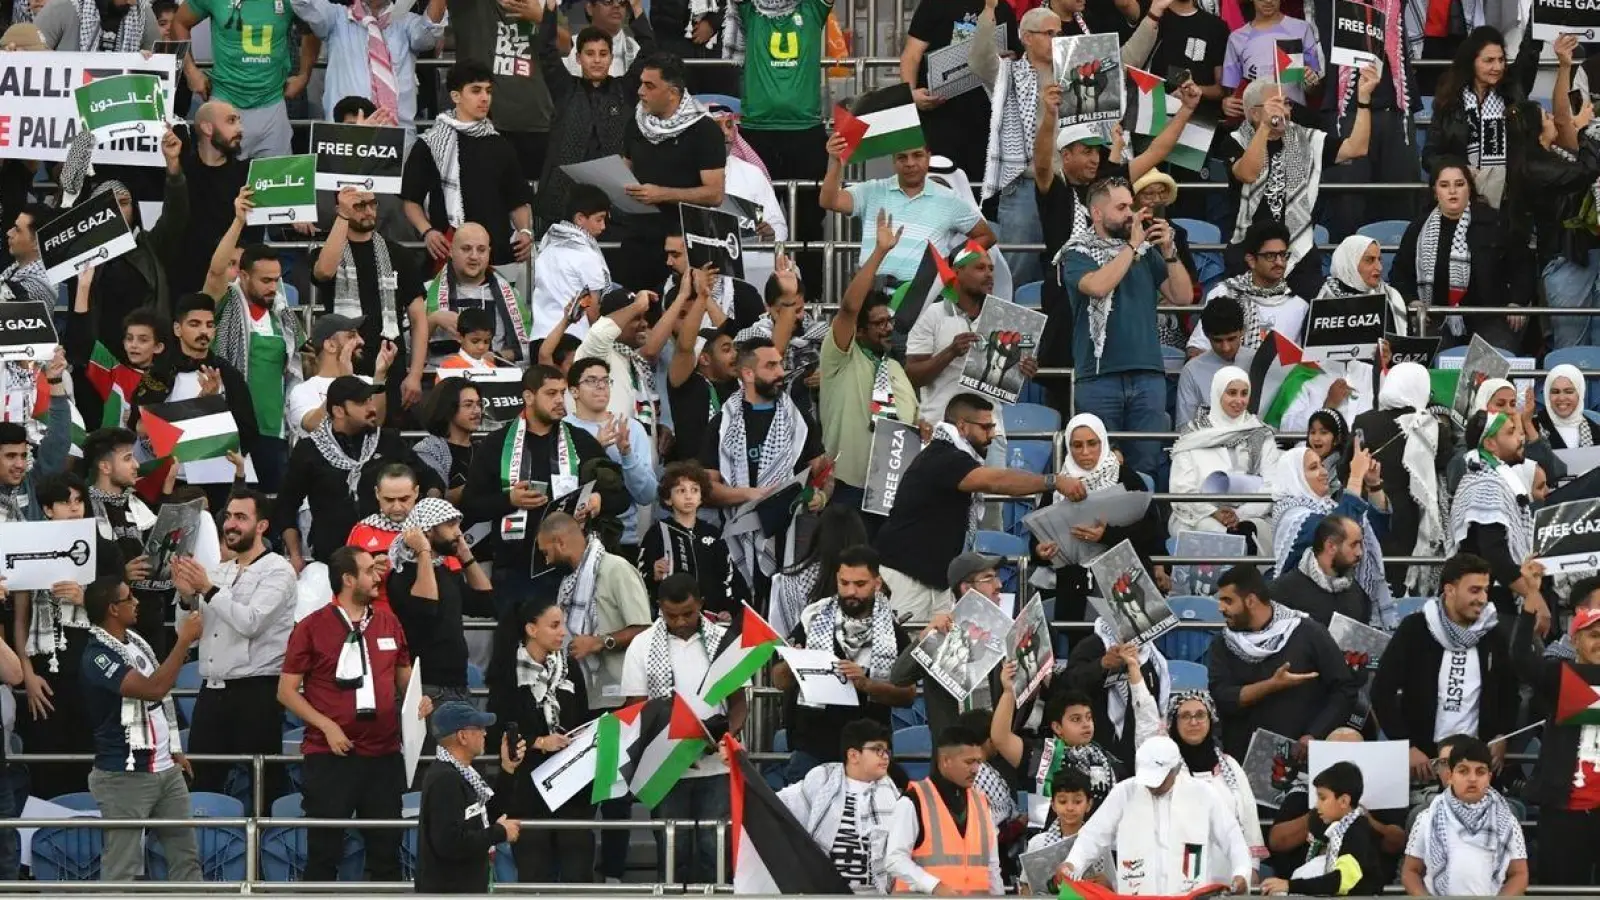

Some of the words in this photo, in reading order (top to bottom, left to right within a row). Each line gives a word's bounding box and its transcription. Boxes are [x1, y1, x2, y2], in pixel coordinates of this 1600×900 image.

[1575, 0, 1600, 10] GA
[1339, 17, 1365, 34] FREE
[317, 141, 353, 156] FREE
[356, 144, 398, 158] GAZA
[44, 226, 76, 251] FREE
[77, 207, 117, 233] GAZA
[739, 215, 756, 232] ZA
[5, 318, 47, 330] GAZA
[1314, 316, 1345, 329] FREE
[1347, 313, 1381, 328] GAZA
[1392, 352, 1428, 364] GAZA
[960, 375, 980, 388] FREE
[980, 381, 1018, 402] PALESTINE
[511, 429, 524, 486] PALESTIN
[889, 429, 906, 470] GAZA
[882, 472, 900, 509] FREE
[1537, 522, 1571, 540] FREE
[677, 535, 689, 572] FREE
[1140, 614, 1178, 641] PALESTINE
[912, 646, 933, 669] FREE
[930, 662, 968, 697] PALESTINE
